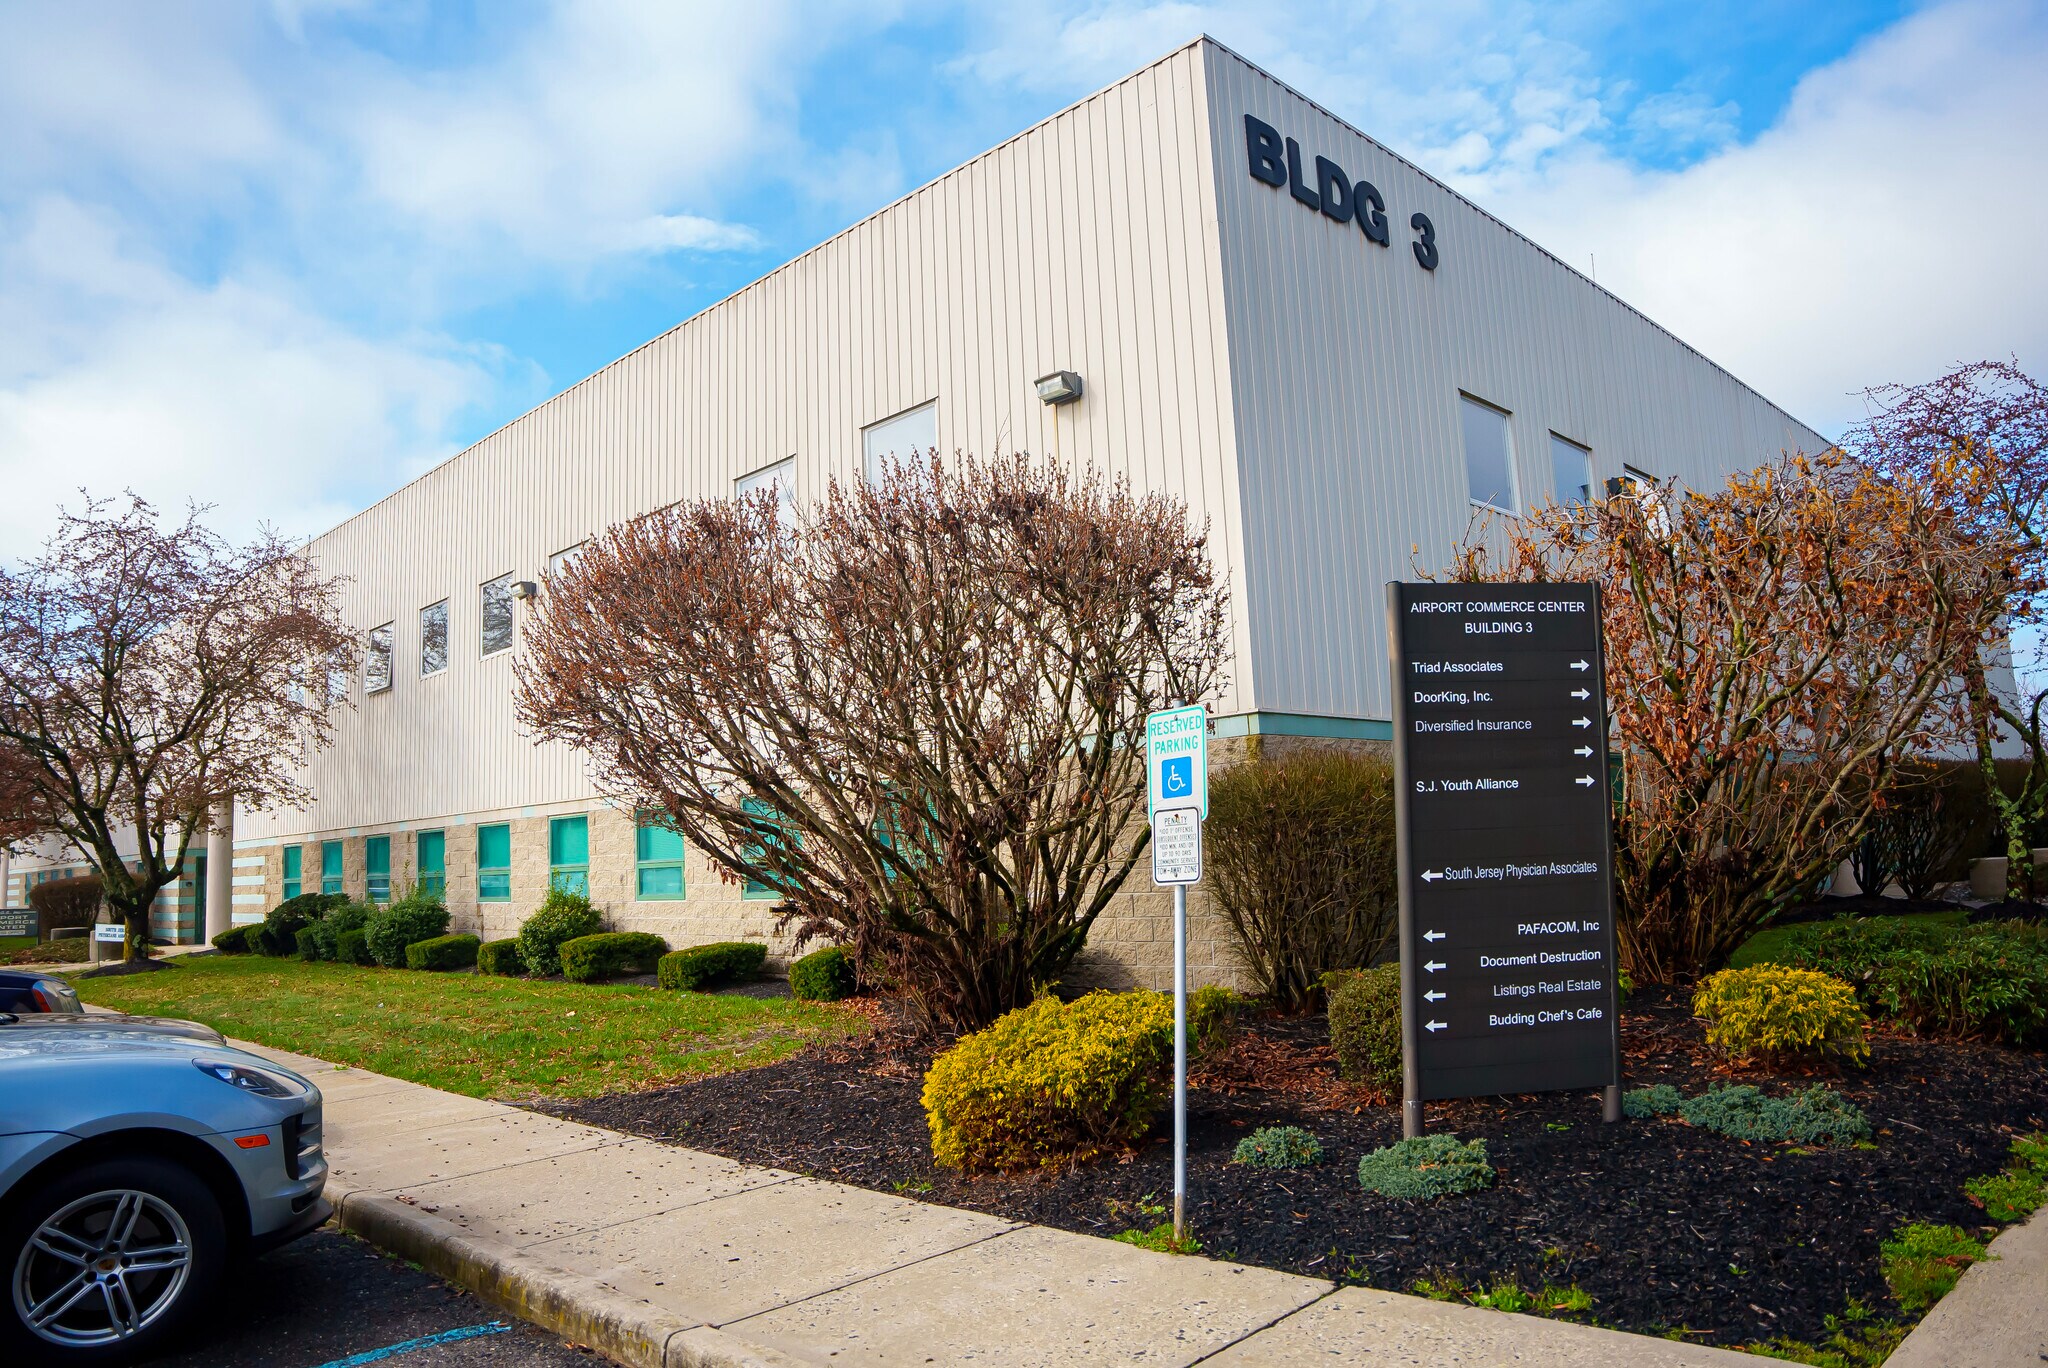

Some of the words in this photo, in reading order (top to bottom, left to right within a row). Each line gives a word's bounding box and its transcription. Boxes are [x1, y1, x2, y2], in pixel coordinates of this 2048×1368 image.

[1244, 114, 1390, 247] BLDG
[1411, 212, 1439, 270] 3
[1411, 602, 1463, 612] AIRPORT
[1466, 602, 1535, 612] COMMERCE
[1538, 602, 1585, 612] CENTER
[1465, 622, 1522, 633] BUILDING
[1526, 622, 1532, 632] 3
[1412, 662, 1440, 673] Triad
[1443, 661, 1503, 672] Associates
[1415, 691, 1469, 704] DoorKing,
[1474, 691, 1493, 701] Inc.
[1150, 714, 1201, 737] RESERVED
[1416, 720, 1473, 732] Diversified
[1477, 720, 1531, 730] Insurance
[1154, 735, 1199, 756] PARKING
[1416, 781, 1437, 792] S.J.
[1441, 779, 1472, 791] Youth
[1475, 778, 1518, 789] Alliance
[1164, 816, 1188, 825] PENALTY
[1184, 865, 1197, 873] ZONE
[1445, 867, 1472, 880] South
[1474, 866, 1504, 880] Jersey
[1506, 863, 1547, 879] Physician
[1550, 861, 1597, 874] Associates
[1518, 921, 1579, 935] PAFACOM,
[1583, 921, 1599, 931] Inc
[1481, 954, 1537, 967] Document
[1540, 950, 1601, 963] Destruction
[1494, 984, 1535, 997] Listings
[1539, 981, 1563, 993] Real
[1567, 979, 1601, 991] Estate
[1490, 1013, 1534, 1025] Budding
[1538, 1010, 1573, 1022] Chef's
[1577, 1008, 1602, 1019] Cafe
